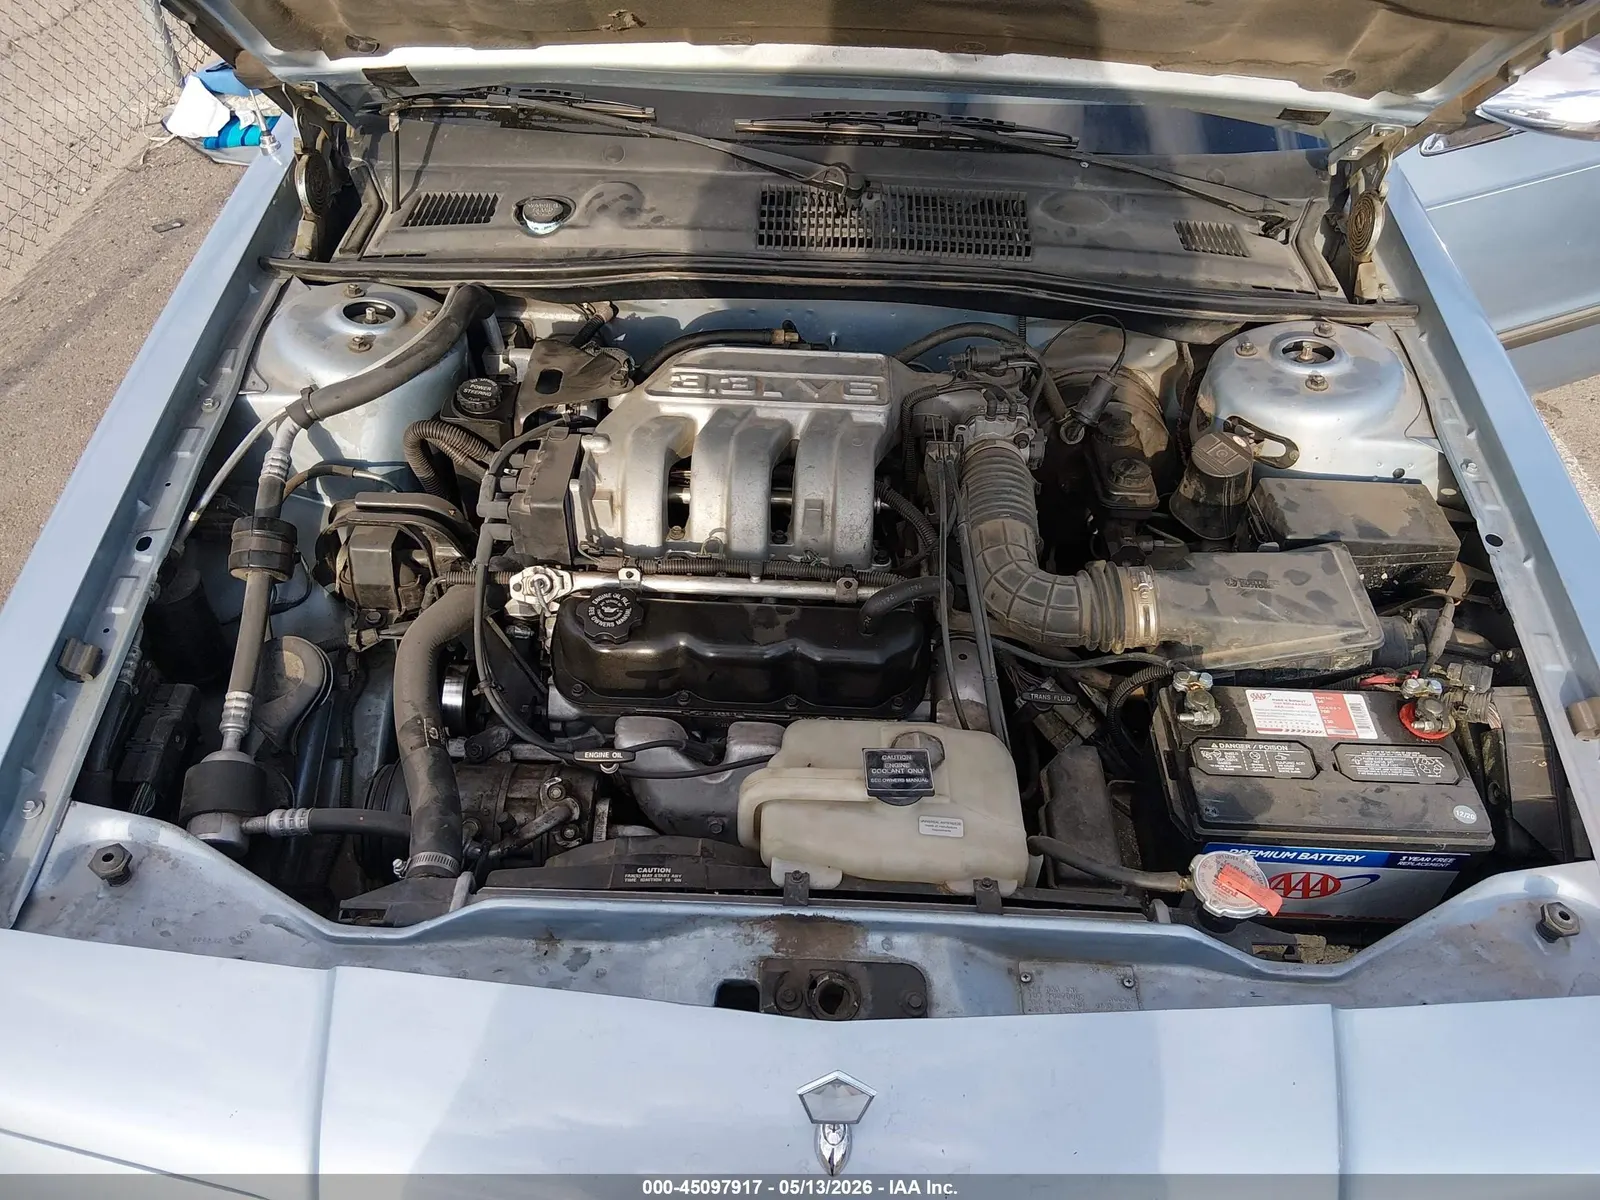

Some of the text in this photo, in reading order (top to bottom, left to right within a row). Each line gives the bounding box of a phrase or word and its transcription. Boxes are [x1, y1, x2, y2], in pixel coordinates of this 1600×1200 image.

[470, 383, 492, 391] POWER
[463, 388, 492, 397] STEERING
[592, 593, 612, 605] ENGINE
[621, 597, 630, 606] FILL
[616, 608, 632, 625] MANUAL
[1053, 694, 1072, 702] FLUID
[1219, 742, 1251, 750] DANGER
[611, 751, 624, 759] OIL
[1455, 809, 1476, 820] 12/20
[1297, 851, 1367, 863] BATTERY
[1269, 871, 1340, 899] AAA
